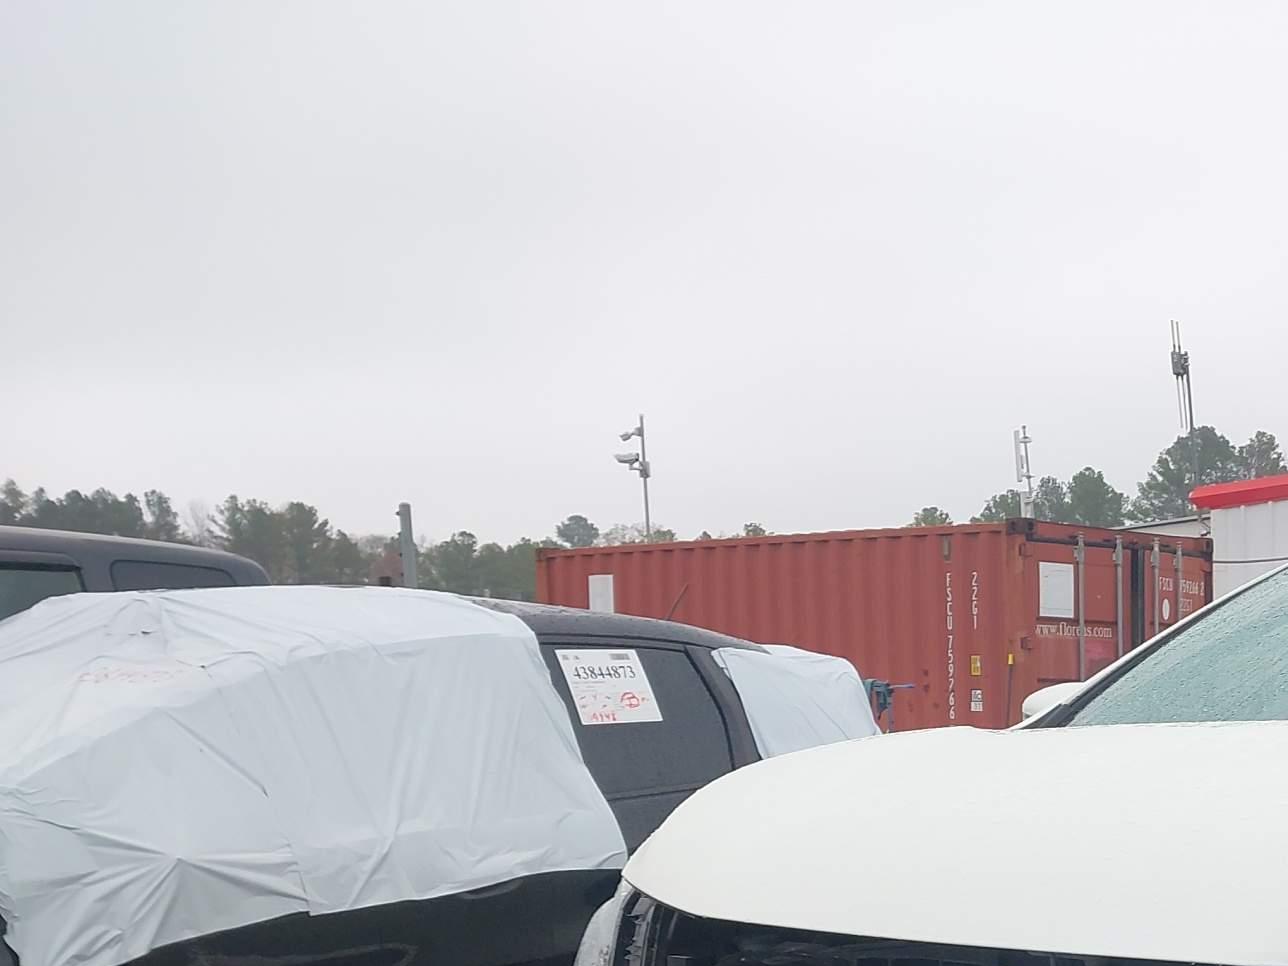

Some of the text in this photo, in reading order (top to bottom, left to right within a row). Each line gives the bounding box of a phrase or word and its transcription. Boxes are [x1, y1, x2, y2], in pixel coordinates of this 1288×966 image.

[971, 571, 979, 630] 22G1
[572, 665, 636, 680] 43844873
[945, 572, 955, 720] FSCU 759766
